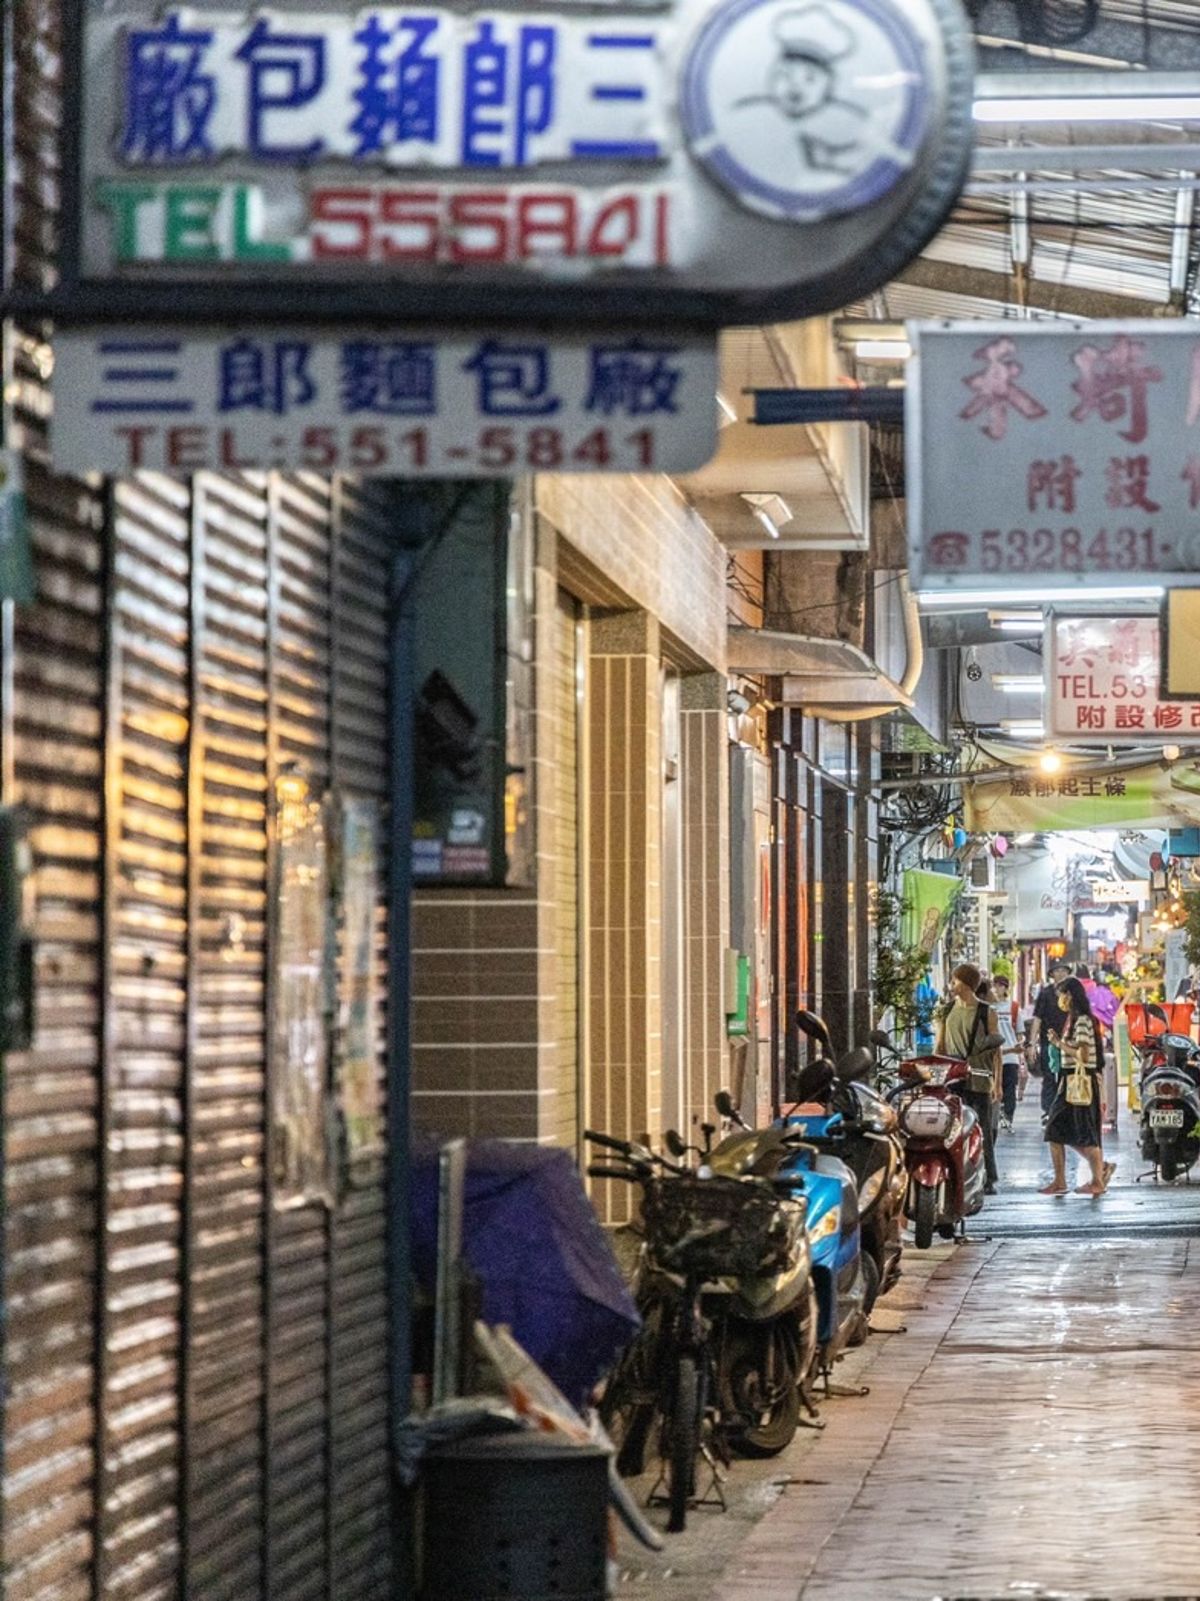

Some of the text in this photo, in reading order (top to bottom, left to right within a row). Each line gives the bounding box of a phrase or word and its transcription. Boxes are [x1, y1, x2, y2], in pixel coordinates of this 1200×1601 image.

[91, 337, 684, 417] 三郎麵包廠
